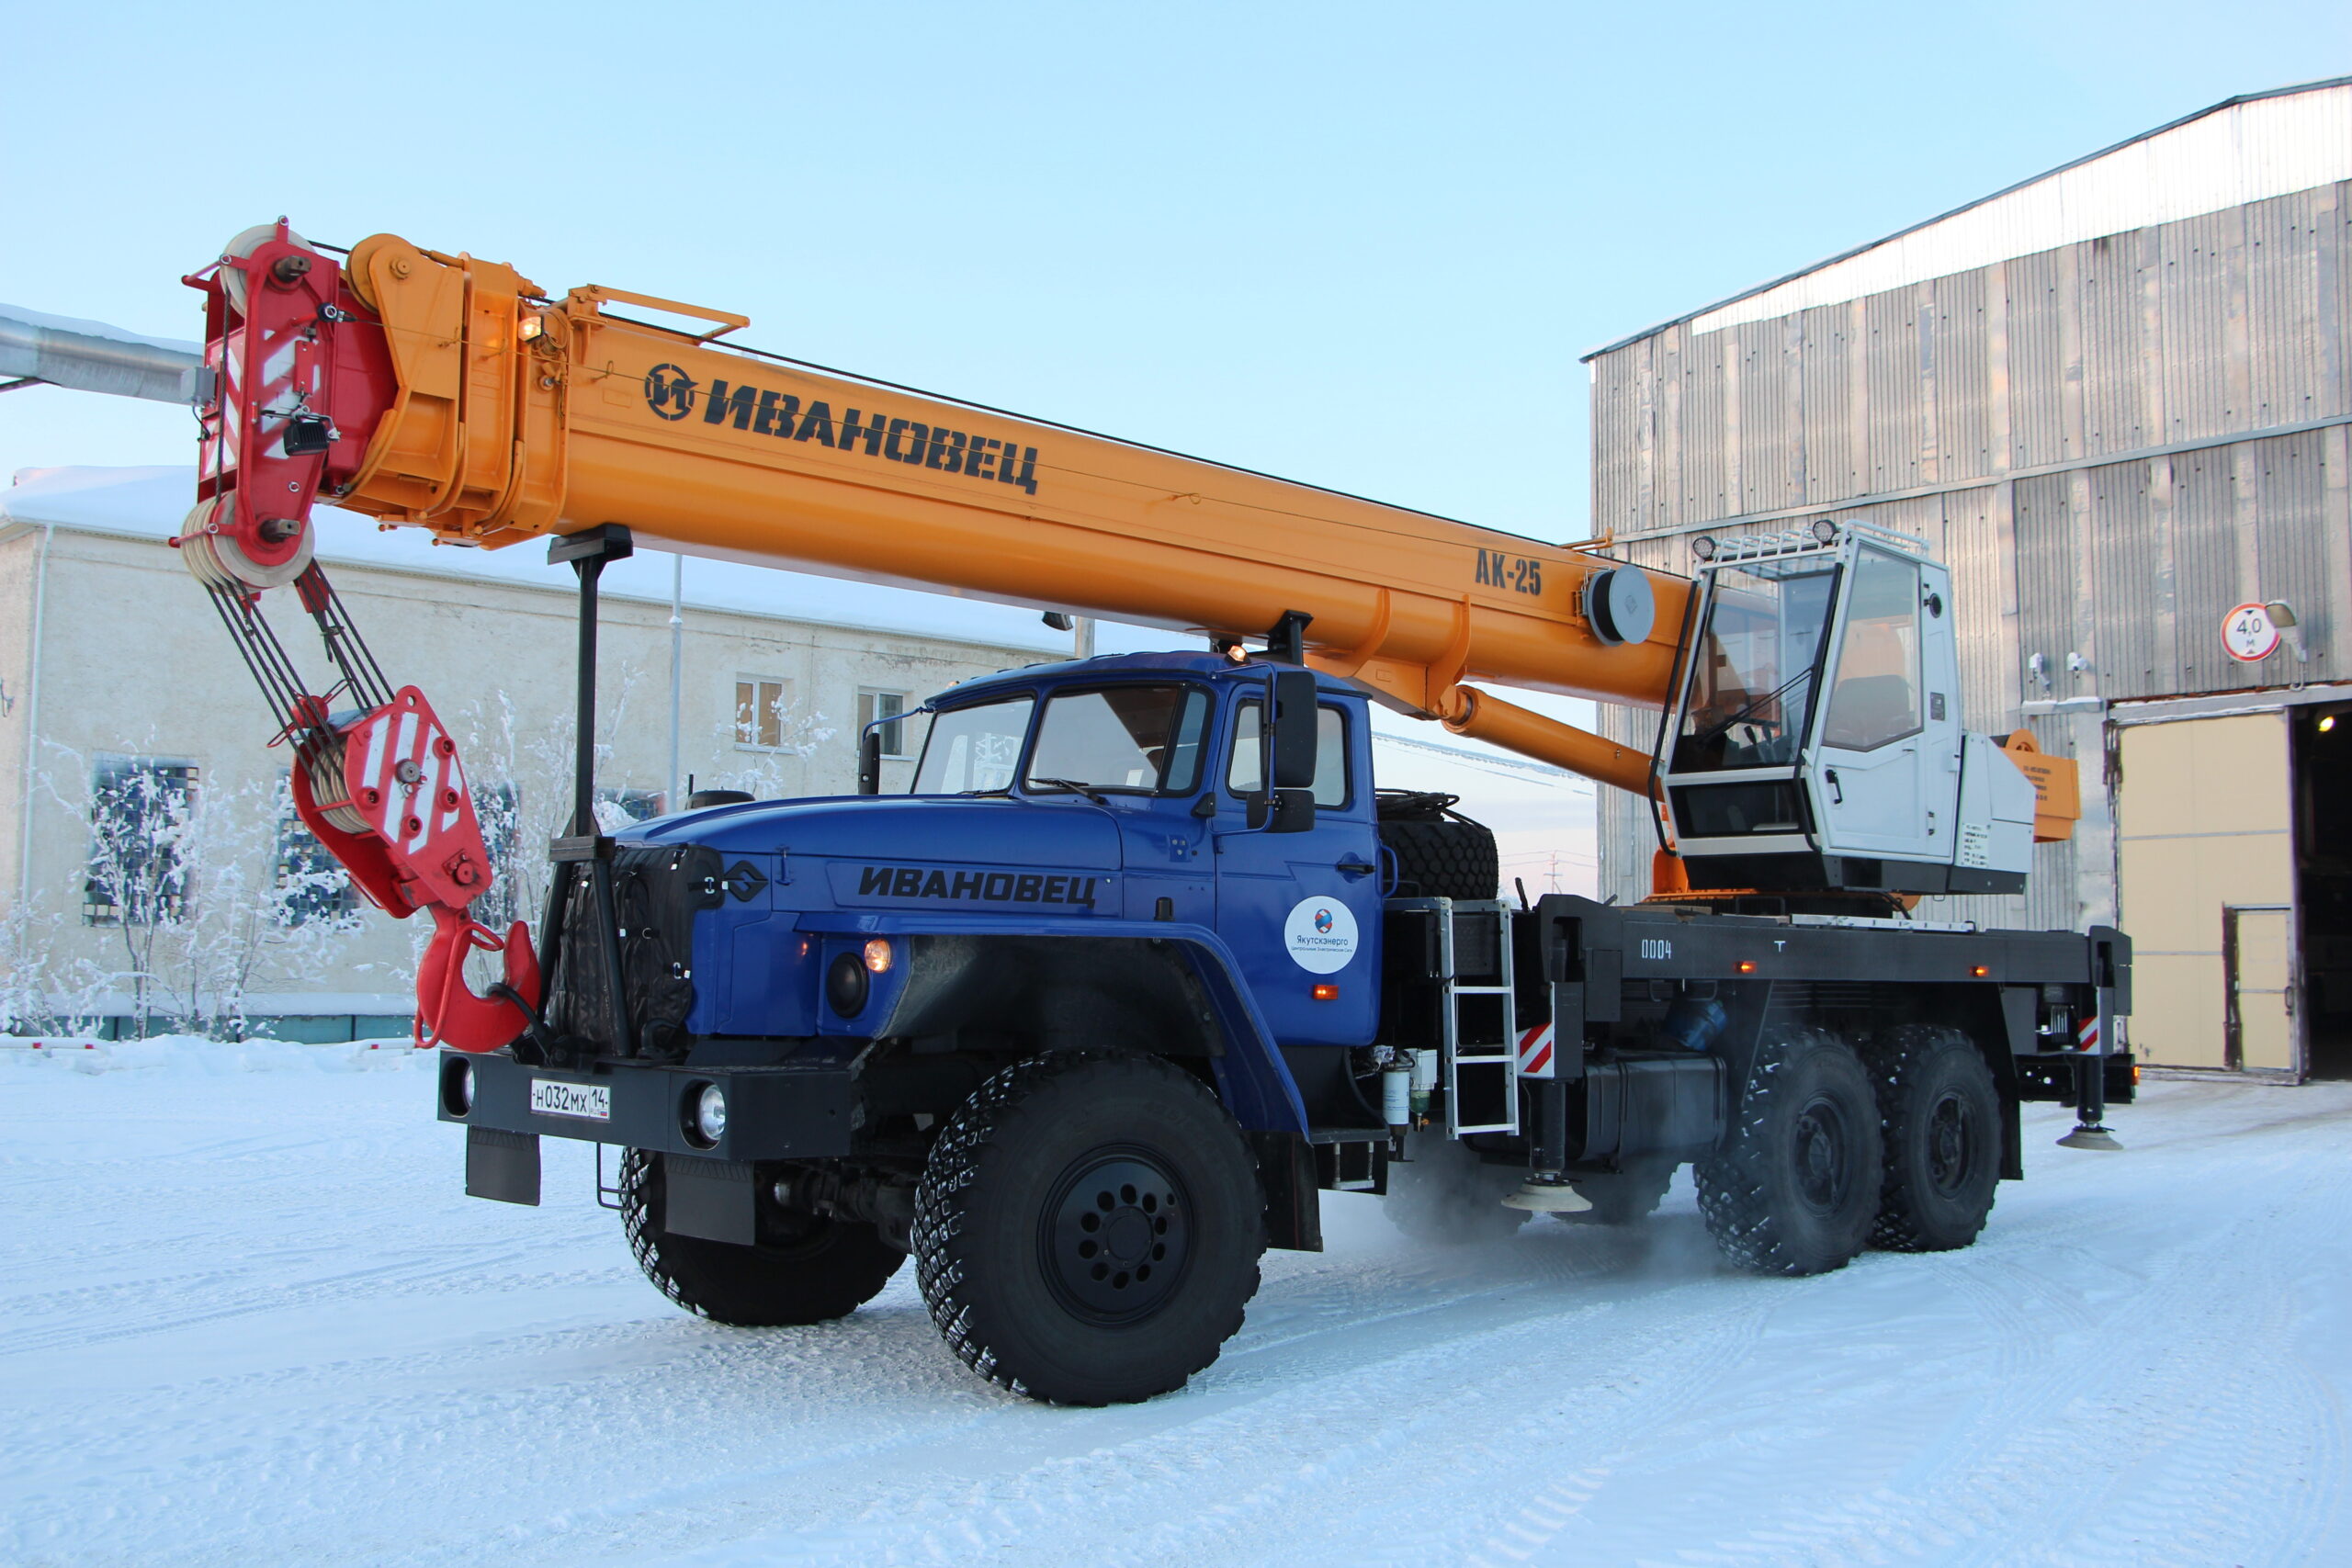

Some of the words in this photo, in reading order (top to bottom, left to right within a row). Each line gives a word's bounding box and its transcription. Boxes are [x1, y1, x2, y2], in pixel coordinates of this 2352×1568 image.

[703, 378, 1038, 496] ИВАНОВЕЦ
[1476, 548, 1542, 596] АК-25
[858, 866, 1096, 909] ИВАНОВЕЦ
[1296, 934, 1349, 947] Якутскэнерго
[1641, 939, 1672, 960] 0004
[536, 1085, 588, 1113] Н032МХ
[591, 1089, 605, 1109] 14
